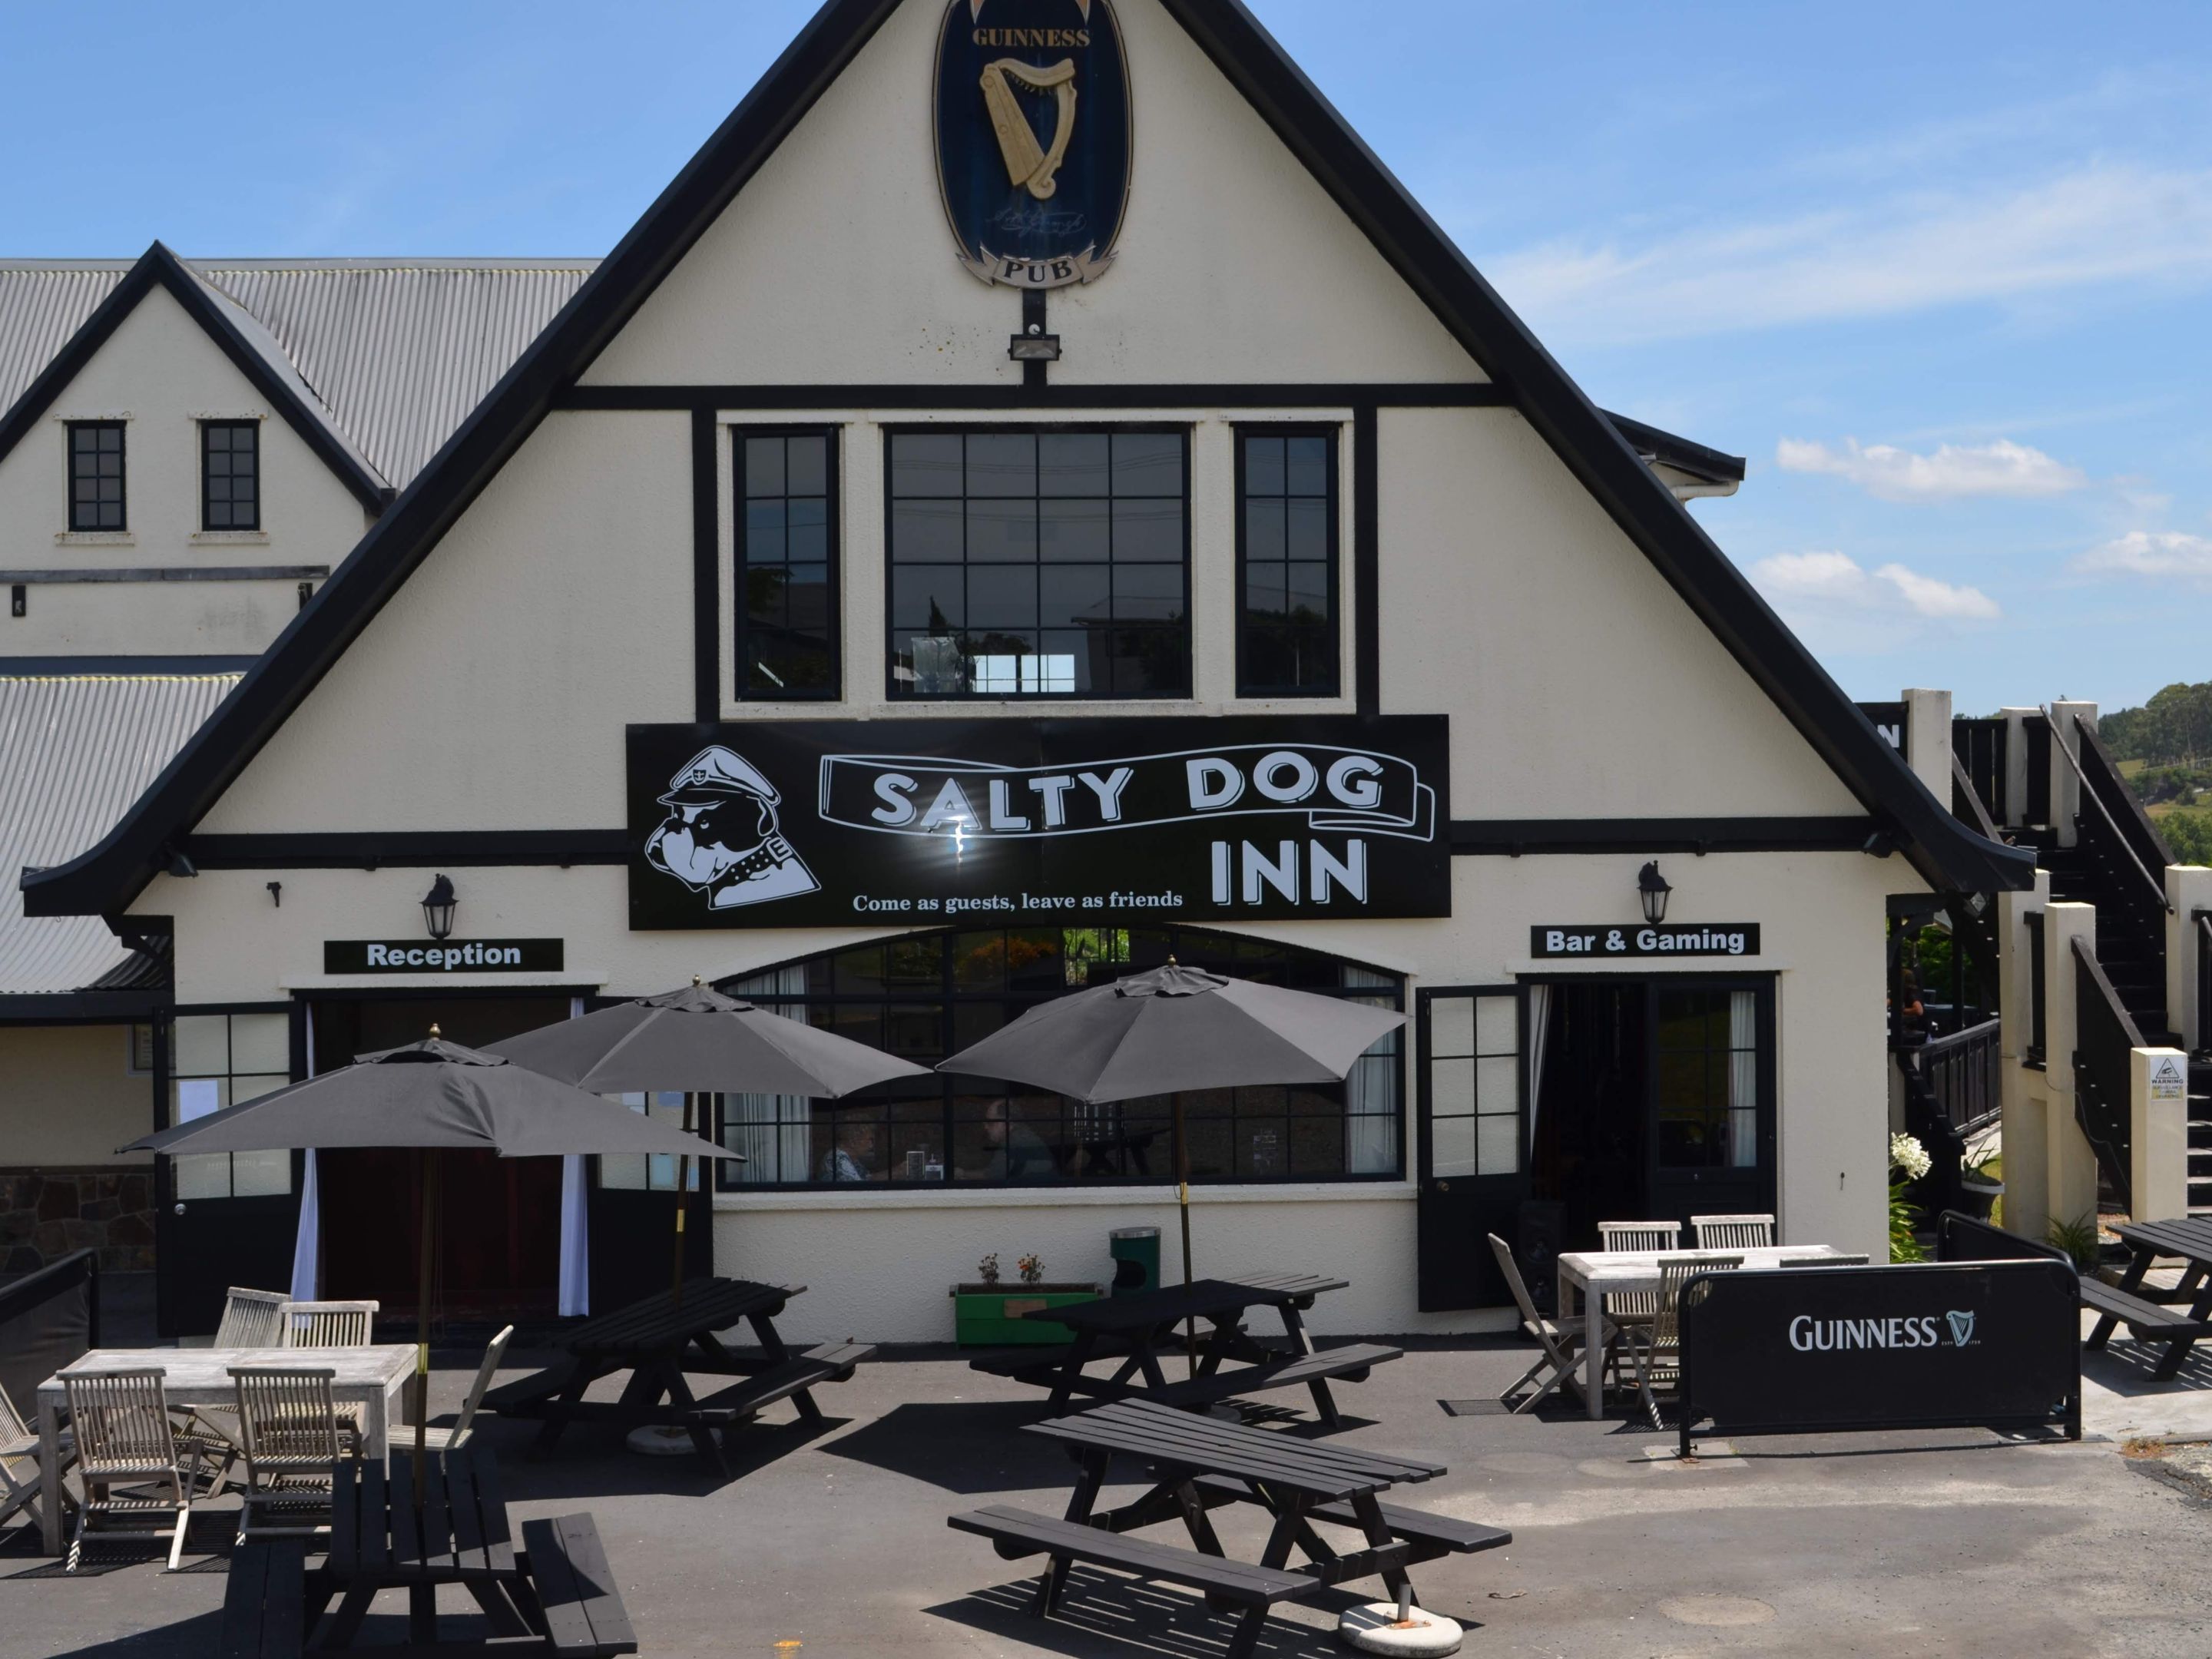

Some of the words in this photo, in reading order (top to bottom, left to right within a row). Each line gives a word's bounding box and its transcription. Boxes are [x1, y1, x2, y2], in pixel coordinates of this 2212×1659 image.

[972, 28, 1091, 47] GUINNESS
[1003, 259, 1072, 283] PUB
[871, 767, 1134, 832] SALTY
[1186, 751, 1384, 811] DOG
[1211, 839, 1367, 906] INN
[853, 895, 911, 912] Come
[917, 899, 939, 911] as
[945, 897, 1015, 914] guests,
[1022, 892, 1075, 909] leave
[1081, 896, 1104, 909] as
[1109, 890, 1183, 908] friends
[1546, 931, 1596, 952] Bar
[1605, 929, 1626, 951] &
[1636, 929, 1744, 954] Gaming
[367, 942, 521, 970] Reception
[1789, 1315, 1937, 1351] GUINNESS
